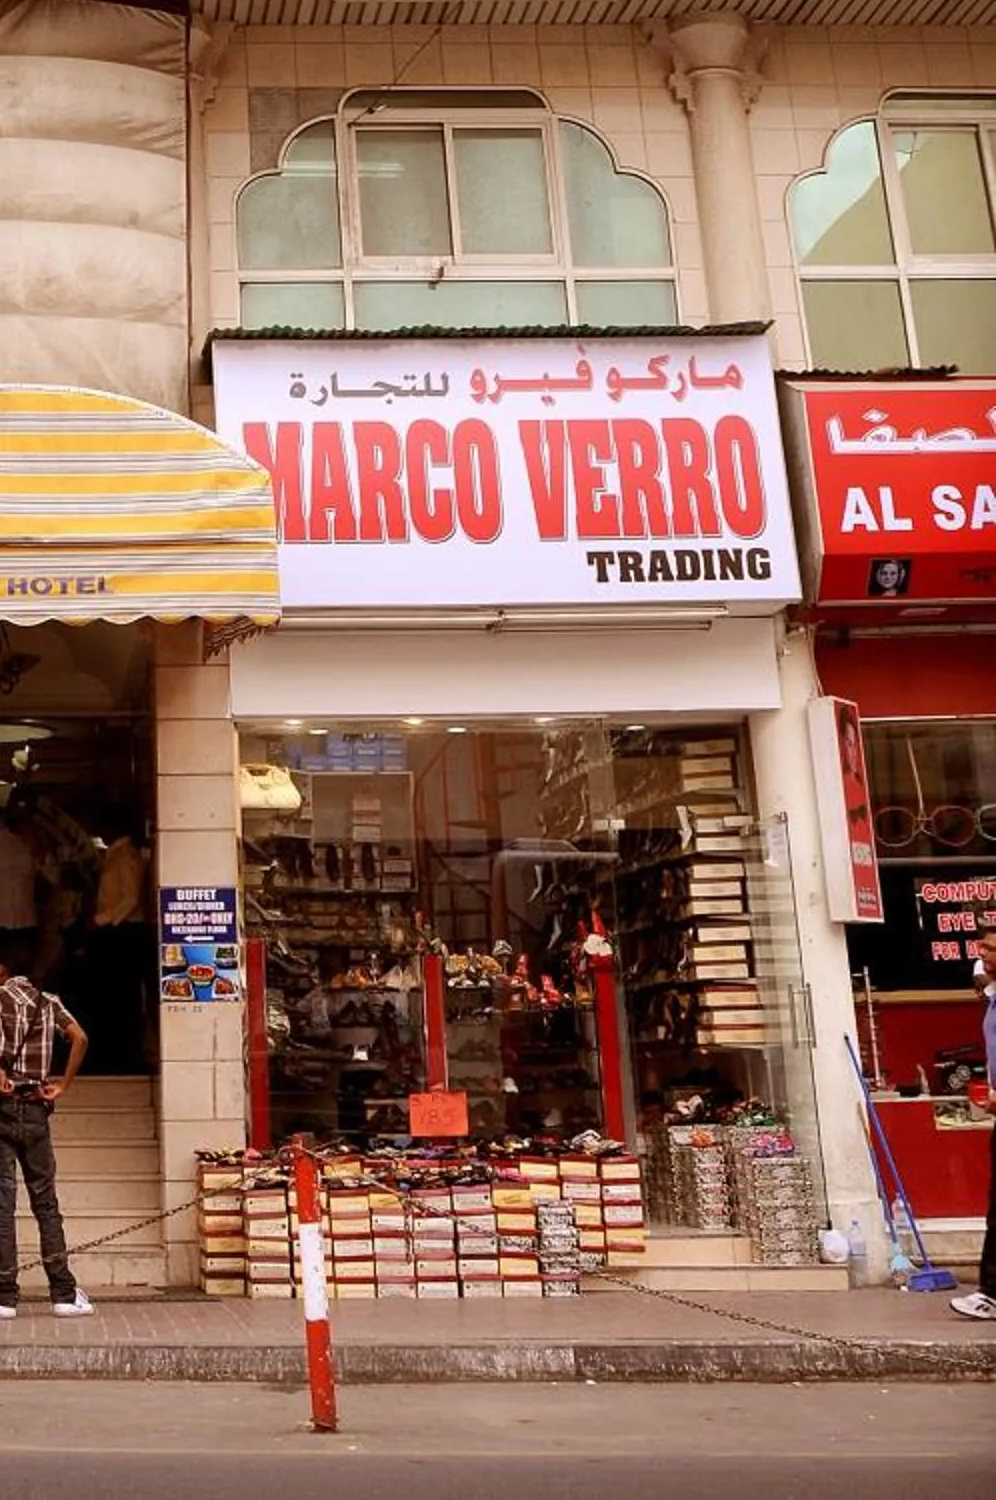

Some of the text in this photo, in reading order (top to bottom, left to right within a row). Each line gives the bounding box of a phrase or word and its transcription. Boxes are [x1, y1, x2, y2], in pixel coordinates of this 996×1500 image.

[289, 346, 744, 406] ماركو فيرو للتجارة
[242, 413, 767, 545] MARCO VERRO
[841, 485, 914, 532] AL
[586, 547, 772, 583] TRADING
[7, 576, 113, 596] HOTEL
[176, 889, 217, 901] BUFFET
[936, 911, 977, 933] EYE
